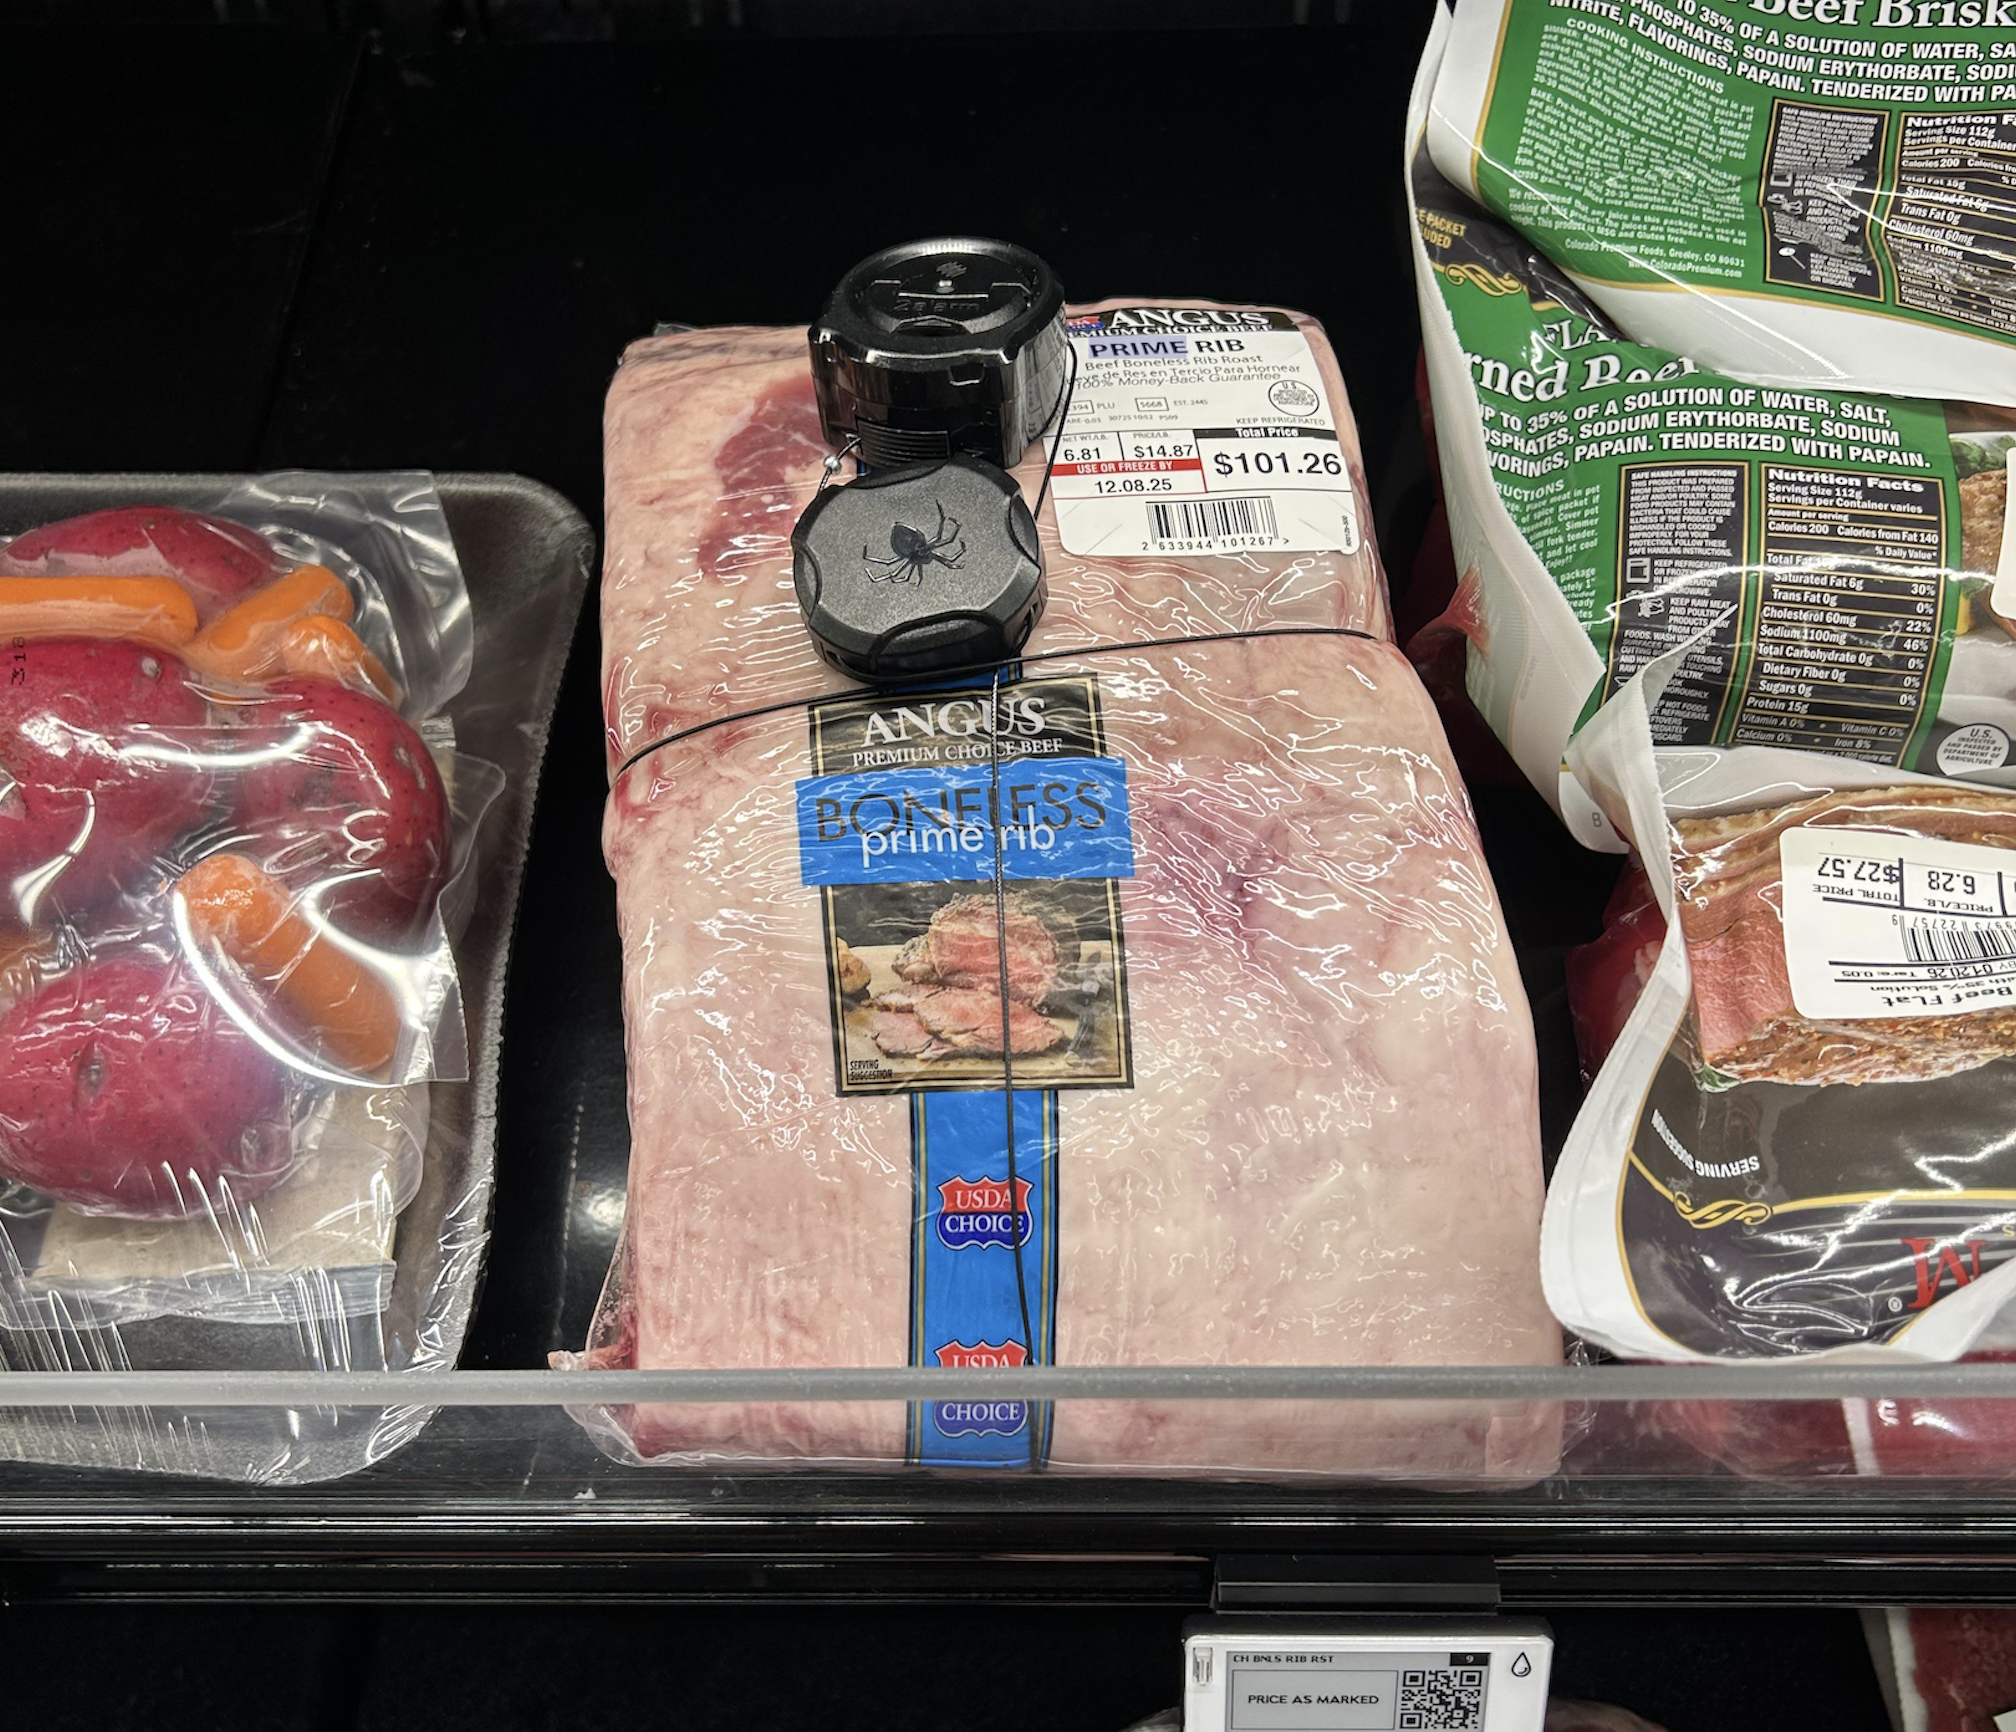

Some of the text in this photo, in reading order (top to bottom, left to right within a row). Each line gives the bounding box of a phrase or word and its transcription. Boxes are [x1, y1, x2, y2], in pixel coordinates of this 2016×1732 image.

[1676, 0, 1697, 16] TO
[1699, 5, 1735, 35] 35%
[1739, 21, 1764, 42] OF
[1766, 30, 1779, 46] A
[1784, 33, 1876, 58] SOLUTION
[1881, 42, 1907, 58] OF
[1912, 42, 1985, 62] WATER,
[1549, 0, 1625, 26] NITRITE,
[1627, 14, 1733, 75] FLAVORINGS,
[1736, 60, 1806, 93] PAPAIN.
[1811, 79, 1929, 102] TENDERIZED
[1934, 85, 1985, 102] WITH
[1629, 0, 1738, 58] PHOSPHATES,
[1743, 44, 1814, 73] SODIUM
[1819, 59, 1962, 84] ERYTHORBATE,
[1566, 17, 1725, 94] COOKING INSTRUCTIONS
[1906, 116, 1996, 127] Nutrition
[1969, 126, 1995, 139] 112g
[1901, 159, 1959, 168] Calories 200
[1427, 212, 1466, 238] PACKET
[1565, 238, 1599, 252] Colorado
[1640, 243, 1667, 258] Foods,
[1669, 247, 1702, 263] Greeley,
[1704, 252, 1716, 263] CO
[1718, 253, 1745, 268] 80631
[1109, 308, 1270, 329] ANGUS
[1089, 339, 1245, 358] PRIME RIB
[1085, 353, 1263, 371] Beef Boneless Rib Roast
[1103, 364, 1301, 380] de Res en Tercio Para Hornear
[1118, 373, 1205, 387] Money-Back
[1208, 372, 1282, 383] Guarantee
[1097, 401, 1116, 409] PLU
[1500, 388, 1892, 435] TO 35% OF A SOLUTION OF WATER, SALT,
[1236, 416, 1326, 427] KEEP REFRIGERATED
[1579, 410, 1901, 447] SODIUM ERYTHORBATE, SODIUM
[1062, 435, 1083, 444] NET
[1236, 427, 1299, 438] Total Price
[1063, 447, 1102, 462] 6.81
[1134, 444, 1194, 460] $14.87
[1573, 434, 1654, 464] PAPAIN.
[1659, 431, 1786, 453] TENDERIZED
[1791, 438, 1843, 461] WITH
[1848, 445, 1932, 469] PAPAIN.
[1077, 460, 1174, 474] USE OR FREEZE BY
[1214, 451, 1342, 478] $101.26
[1687, 469, 1737, 478] INSTRUCTIONS
[1094, 478, 1173, 495] 12.08.25
[1768, 468, 1925, 494] Nutrition Facts
[1767, 483, 1863, 501] Serving Size 112g
[1768, 521, 1939, 544] Calories 200 Calories from Fat 140
[1142, 536, 1274, 551] 2 633944 101267
[1762, 606, 1931, 634] Cholesterol 60mg 22%
[1760, 624, 1928, 653] Sodium 1100mg 46%
[1746, 697, 1810, 714] Protein 15g
[860, 696, 1046, 748] ANGUS
[1970, 728, 1993, 739] U.S.
[852, 738, 1063, 767] PREMIUM CHOICE BEEF
[1592, 812, 1602, 828] B
[861, 804, 1056, 869] prime rib
[1818, 857, 1976, 895] $27.57 6.28
[1812, 884, 1899, 902] TOTAL PRICE
[1923, 898, 1994, 914] PRICE/LB.
[1912, 916, 1956, 930] 22757
[1841, 963, 1993, 979] 01.20.26 Tare: 0.05
[1942, 981, 1985, 990] 35%
[1949, 986, 2013, 1004] Beef
[850, 1059, 879, 1071] SERVING
[850, 1069, 893, 1081] SUGGESTION
[1695, 1155, 1760, 1178] SERVING
[955, 1188, 1014, 1209] USDA
[944, 1215, 1025, 1233] CHOICE
[941, 1402, 1021, 1422] CHOICE
[1233, 1655, 1334, 1663] CH BNLS RIB RST
[1465, 1654, 1475, 1663] 9
[1248, 1694, 1379, 1704] PRICE AS MARKED
